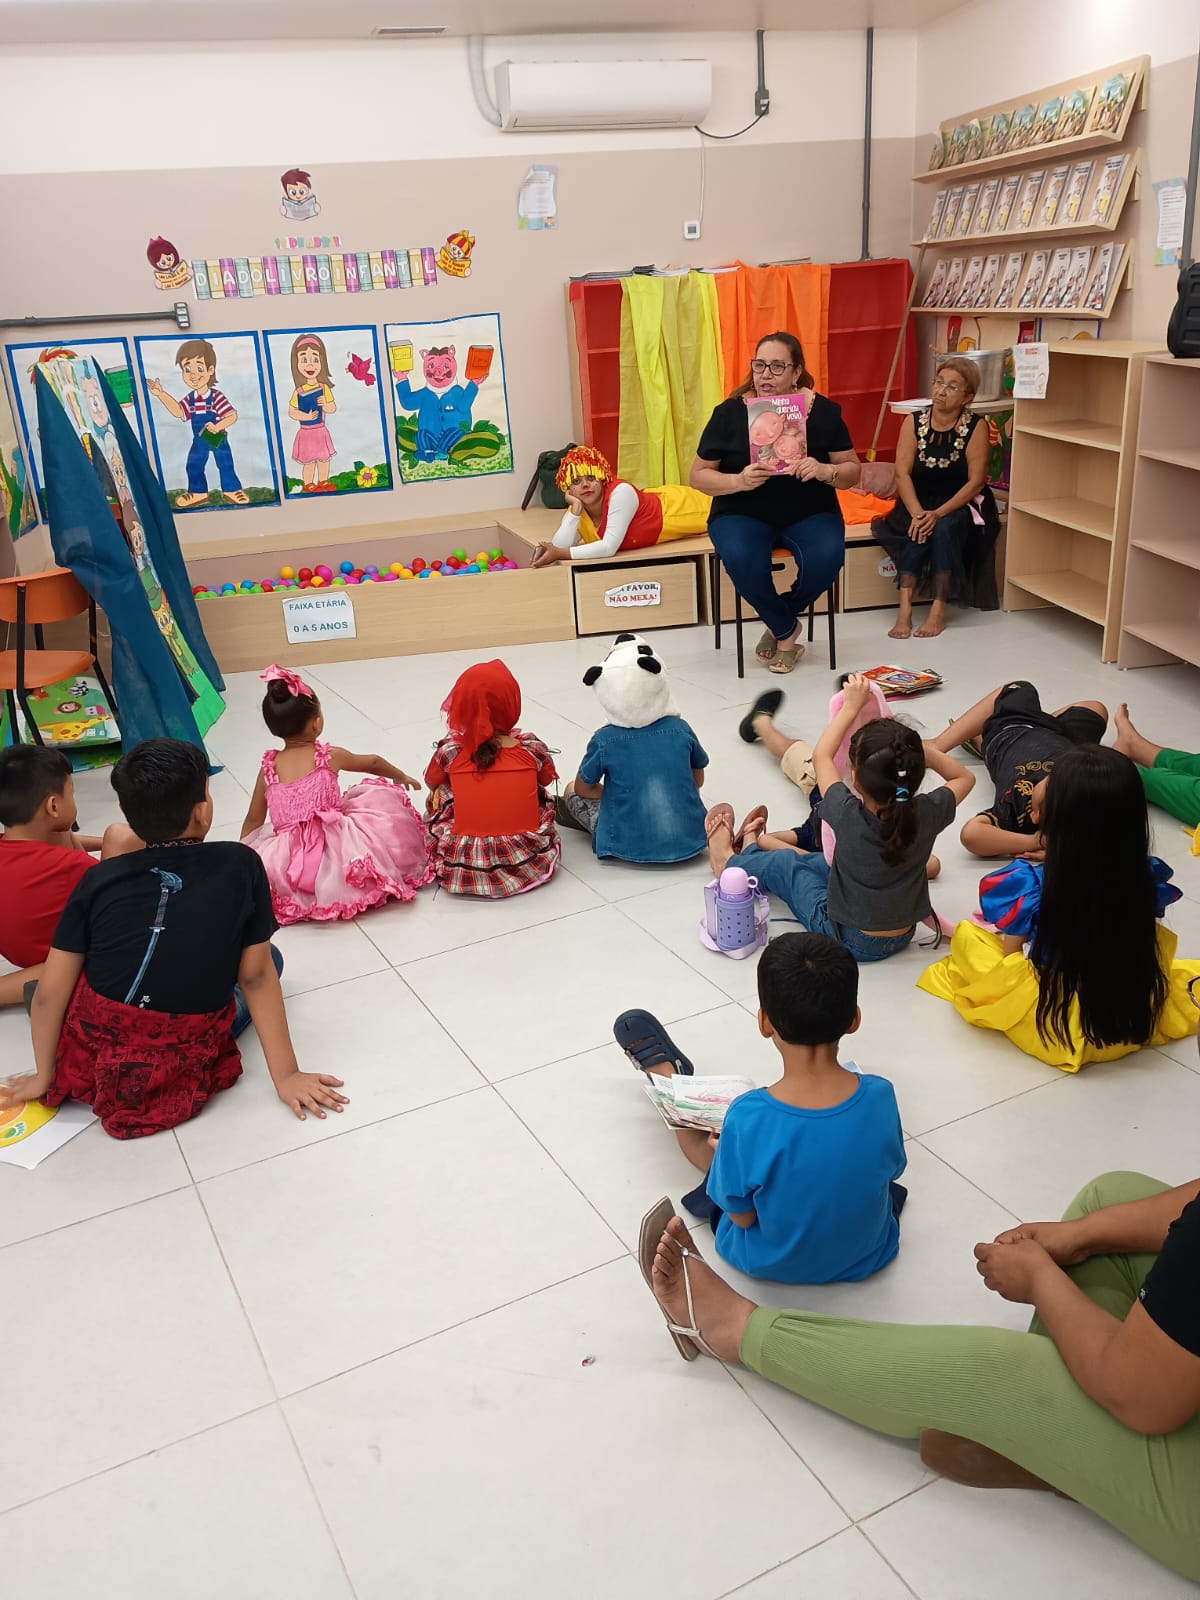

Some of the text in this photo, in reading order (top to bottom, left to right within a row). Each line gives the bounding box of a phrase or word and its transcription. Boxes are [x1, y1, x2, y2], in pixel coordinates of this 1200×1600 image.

[626, 583, 658, 591] FAVOR,
[630, 593, 657, 602] MEXA!
[289, 599, 346, 611] FAIXA ETÁRIA
[302, 624, 309, 632] A
[311, 623, 317, 631] 5
[320, 621, 348, 631] ANOS
